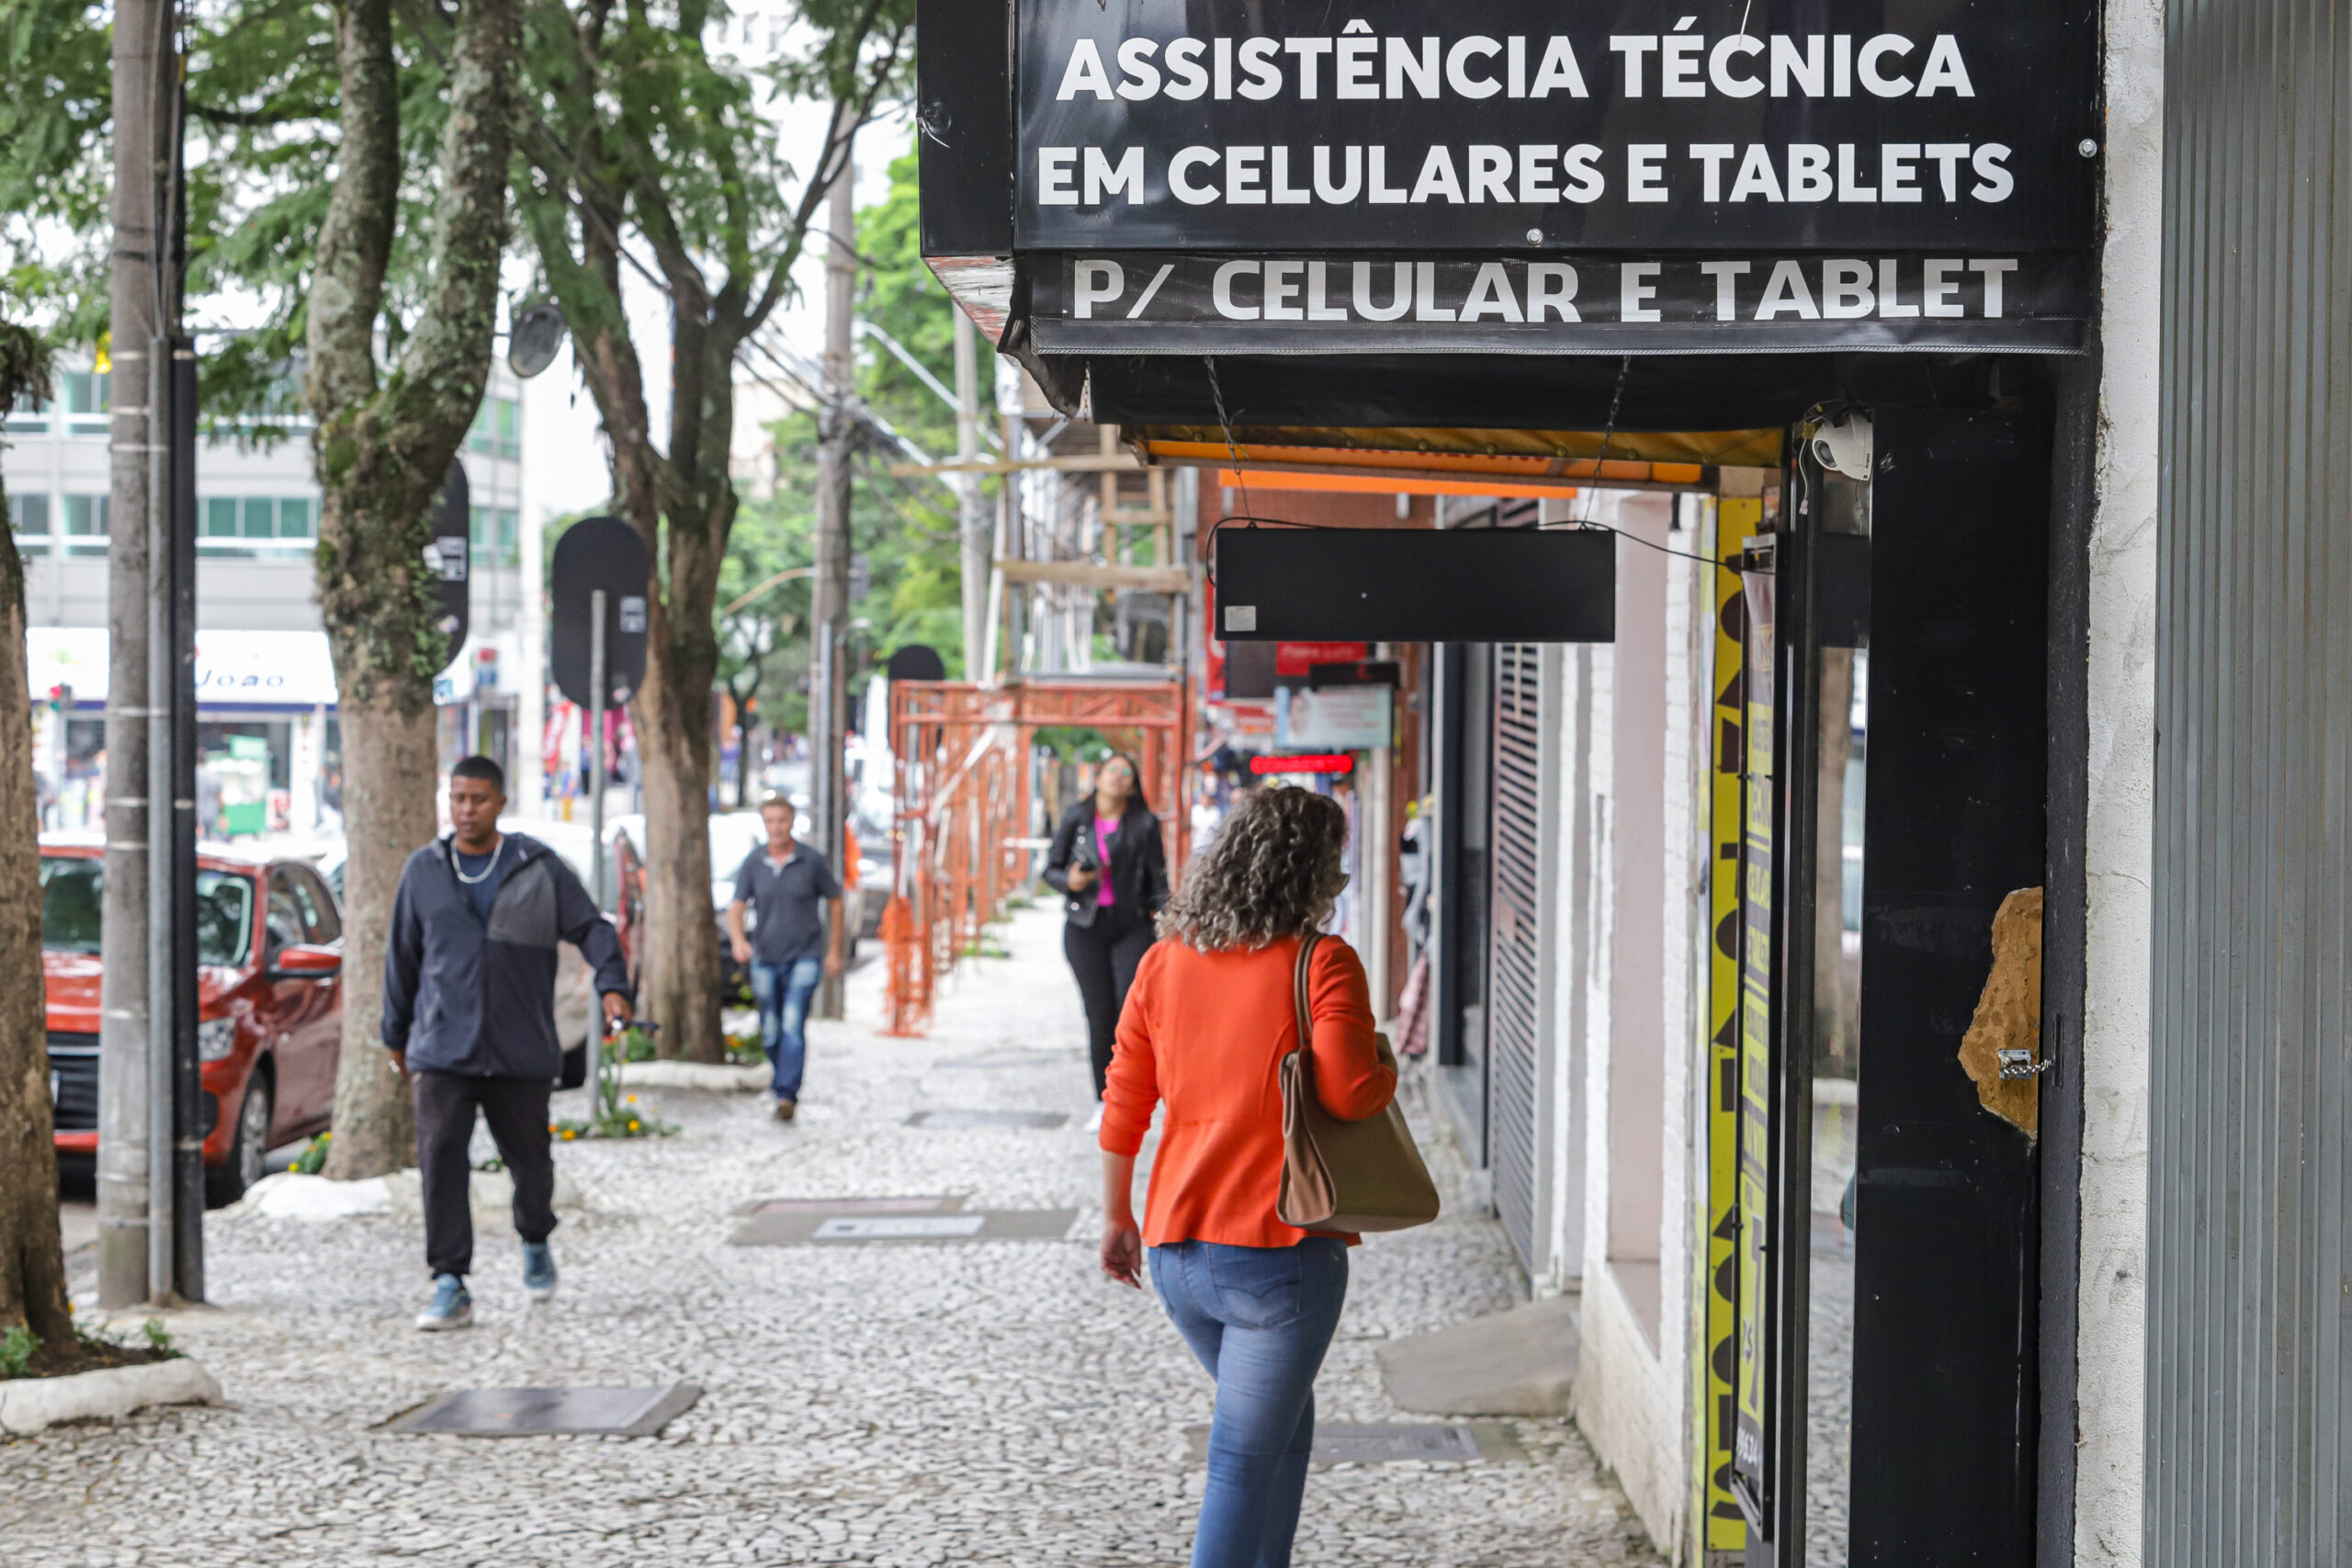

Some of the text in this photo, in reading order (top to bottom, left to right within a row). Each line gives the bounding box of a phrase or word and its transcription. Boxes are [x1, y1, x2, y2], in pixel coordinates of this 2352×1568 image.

[1056, 16, 1975, 101] ASSISTÊNCIA TÉCNICA
[1038, 142, 2015, 206] EM CELULARES E TABLETS
[1073, 258, 2018, 323] P/ CELULAR E TABLET
